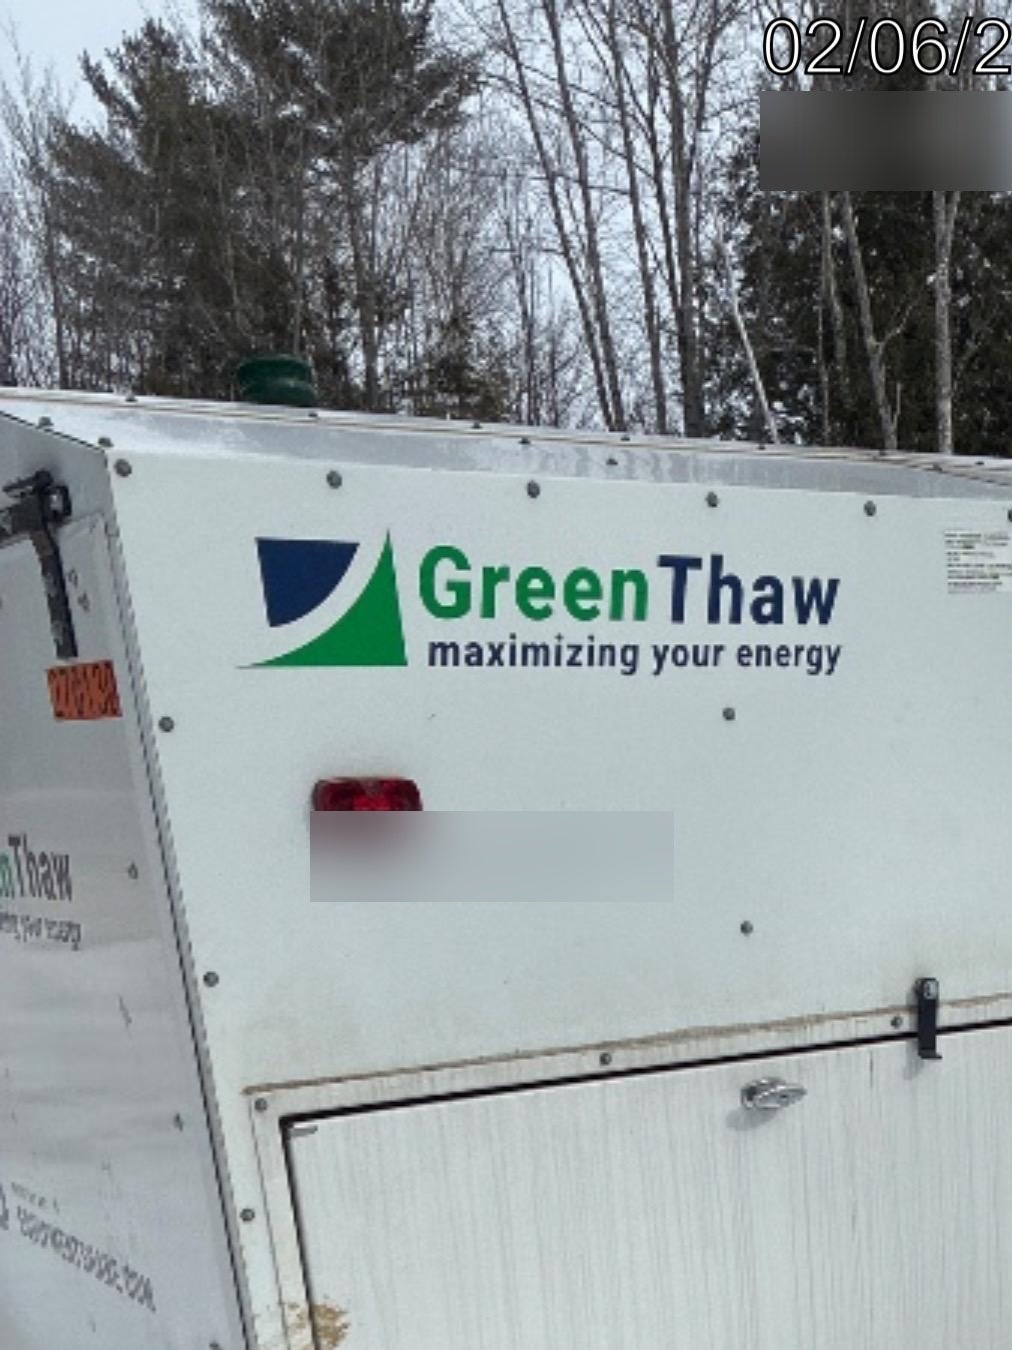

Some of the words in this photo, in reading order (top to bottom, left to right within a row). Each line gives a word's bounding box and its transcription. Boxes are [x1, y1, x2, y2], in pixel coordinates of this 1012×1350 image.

[427, 632, 640, 676] maximizing
[651, 643, 725, 676] your
[736, 643, 842, 676] energy
[0, 832, 72, 902] nThaw
